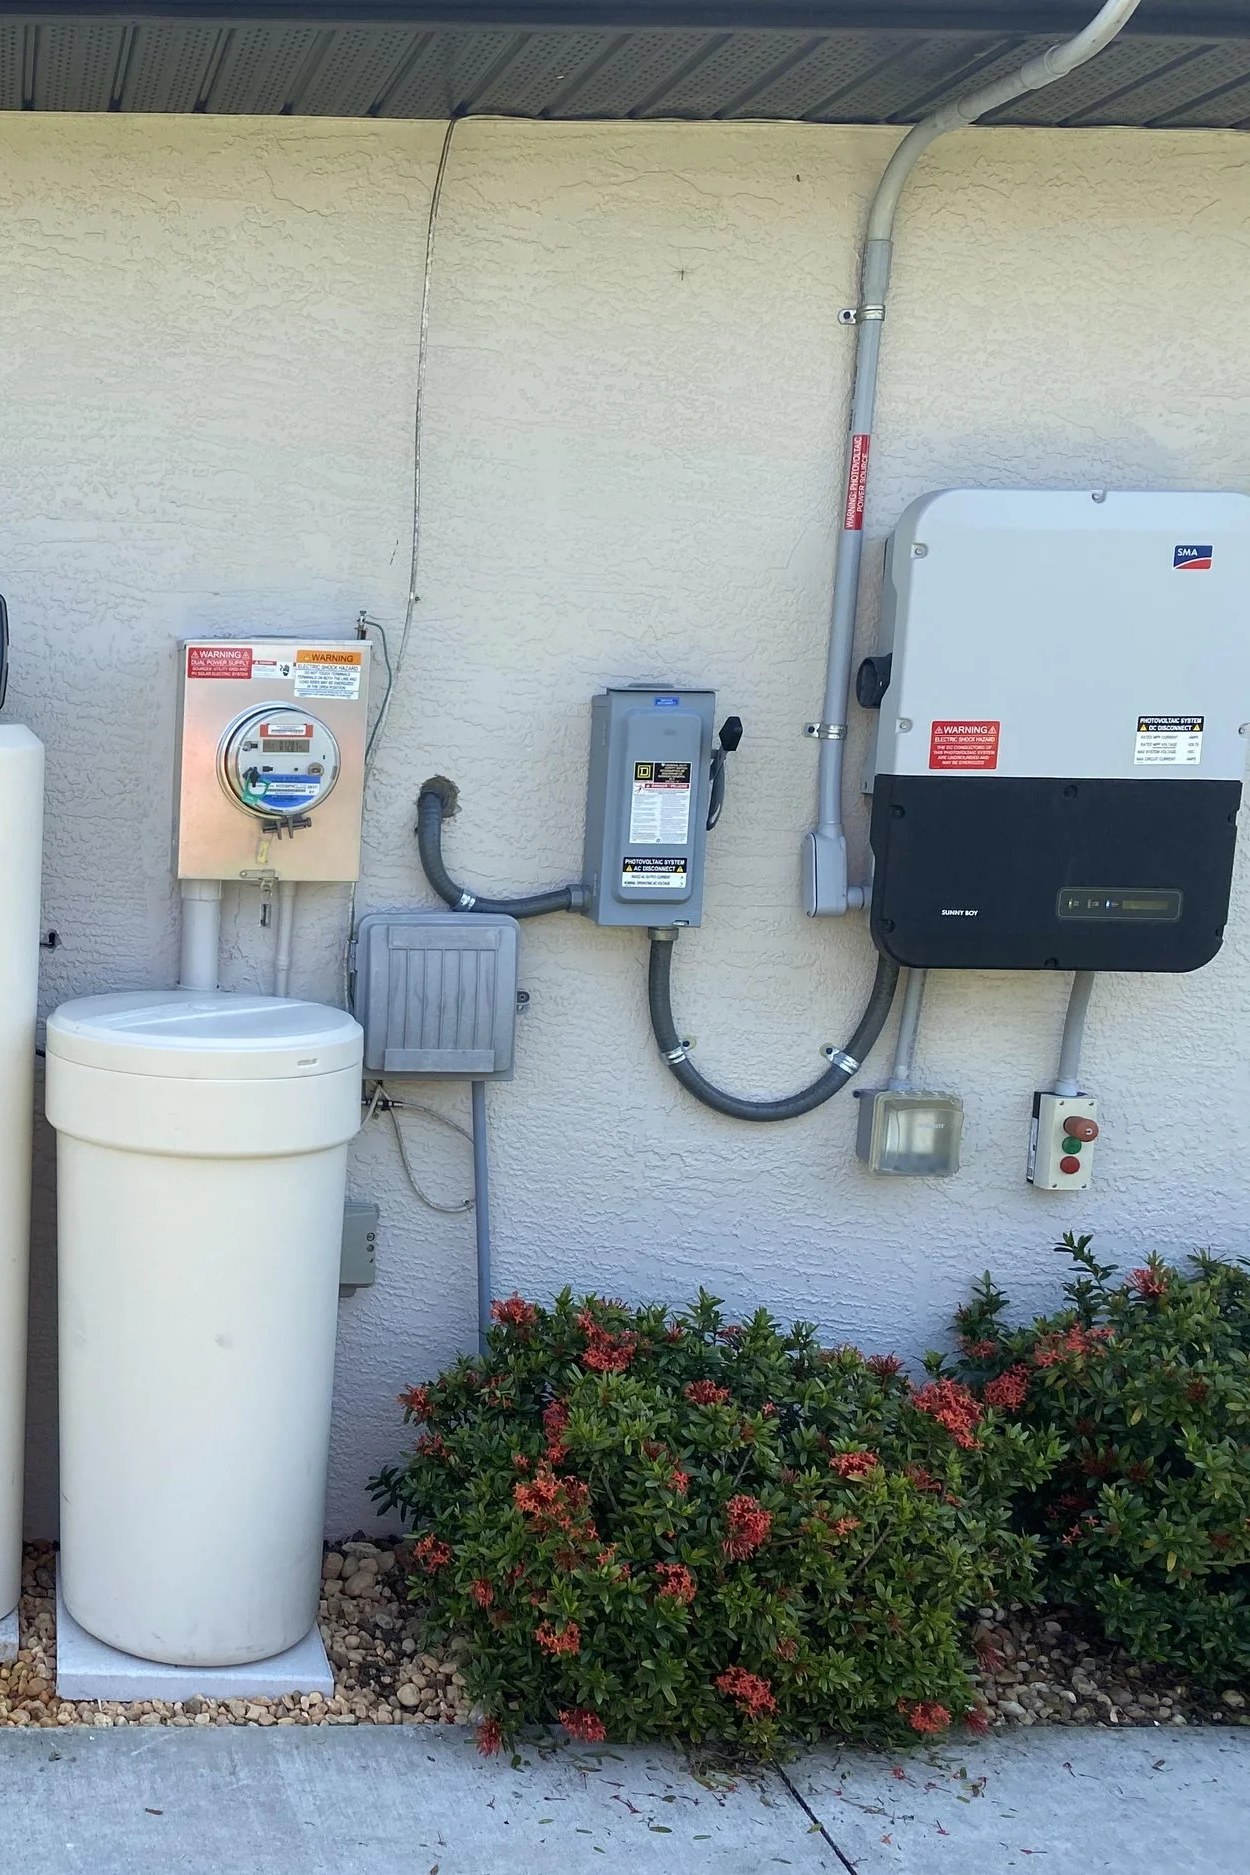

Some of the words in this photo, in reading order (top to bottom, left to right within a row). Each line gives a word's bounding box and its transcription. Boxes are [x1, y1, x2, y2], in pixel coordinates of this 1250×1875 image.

[850, 436, 862, 490] PHOTOVOLTAIC
[860, 453, 868, 484] SOURCE
[857, 485, 865, 512] POWER
[1177, 548, 1198, 556] SMA
[199, 650, 241, 658] WARNING
[311, 654, 354, 663] WARNING
[943, 726, 988, 734] WARNING
